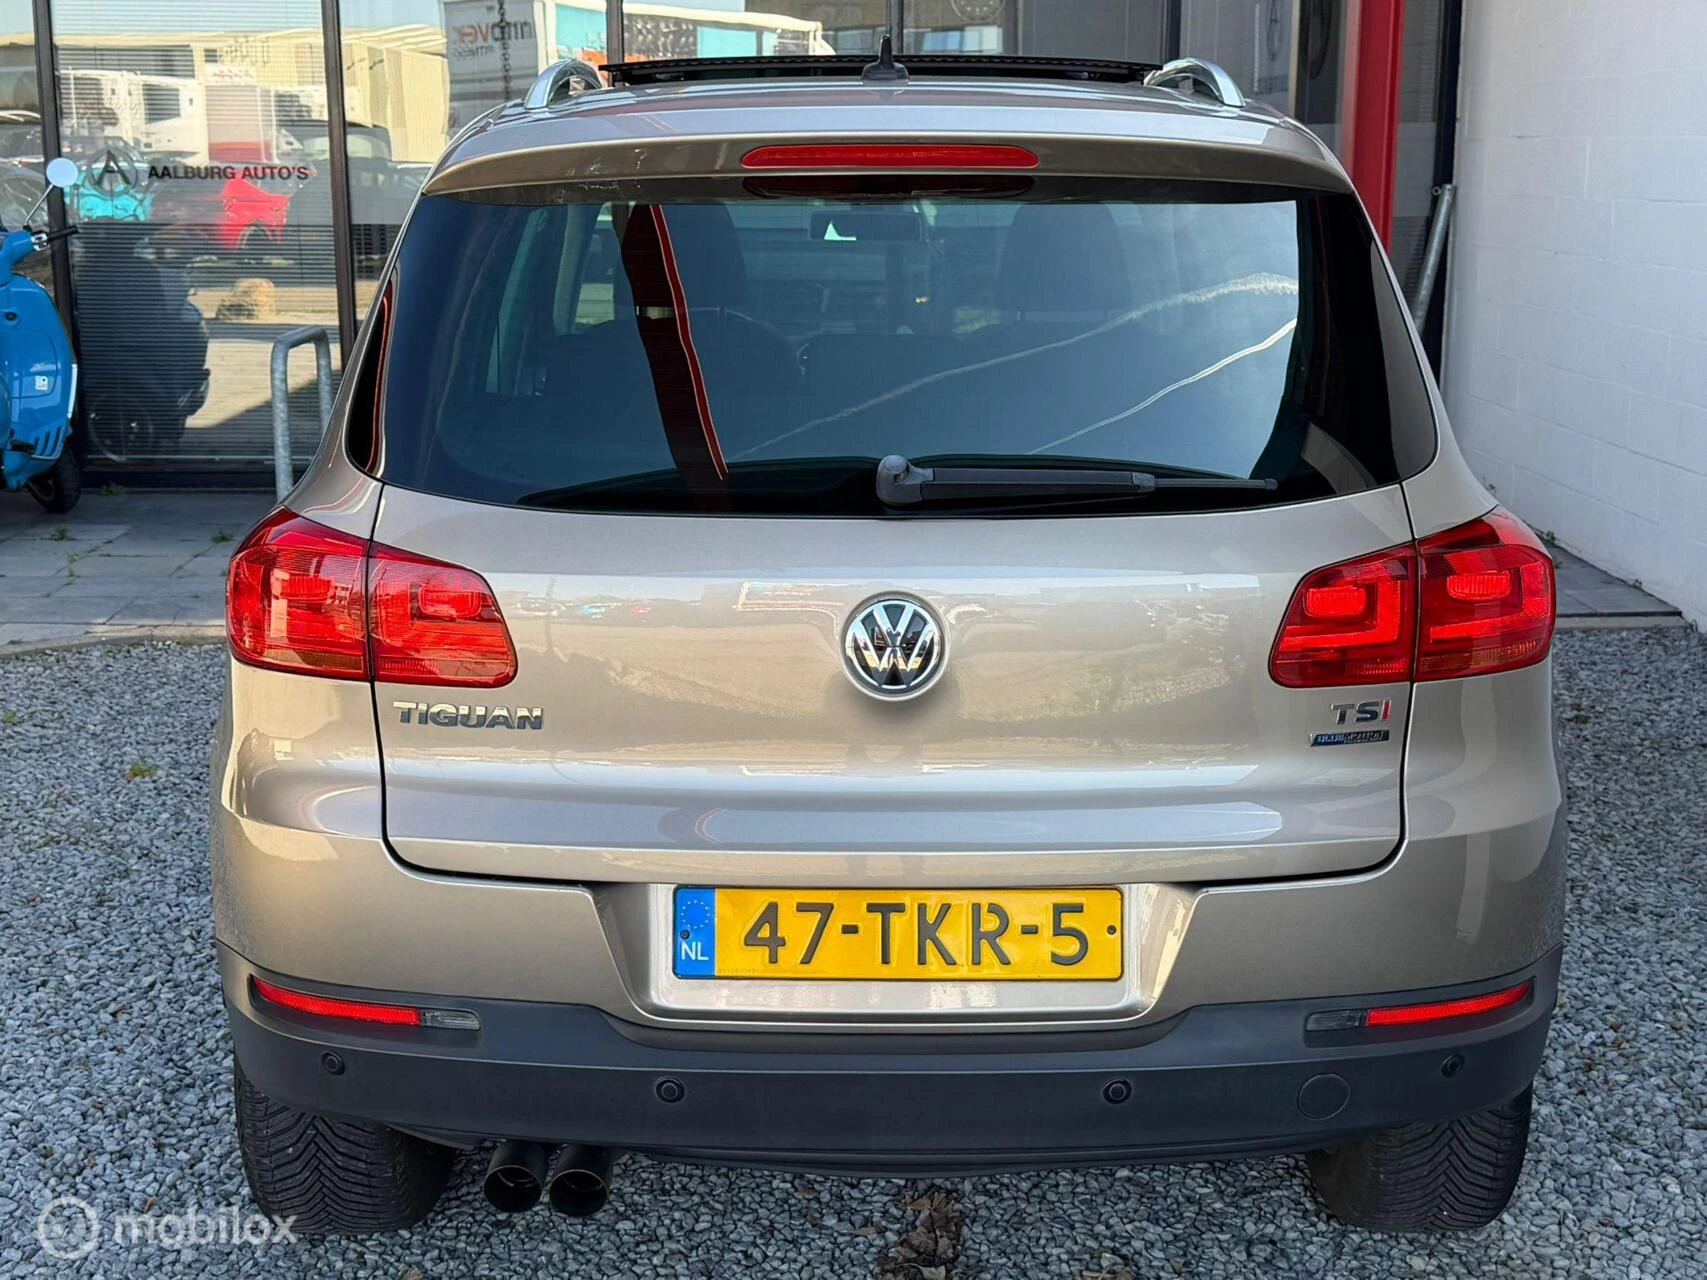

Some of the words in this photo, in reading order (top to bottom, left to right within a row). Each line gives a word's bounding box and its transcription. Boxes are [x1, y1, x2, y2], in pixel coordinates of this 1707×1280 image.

[148, 166, 236, 180] AALBURG
[241, 165, 309, 180] AUTO'S
[392, 701, 543, 730] TIGUAN
[1330, 699, 1392, 725] TSI
[744, 901, 1089, 966] 47-TKR-5
[680, 940, 709, 962] NL
